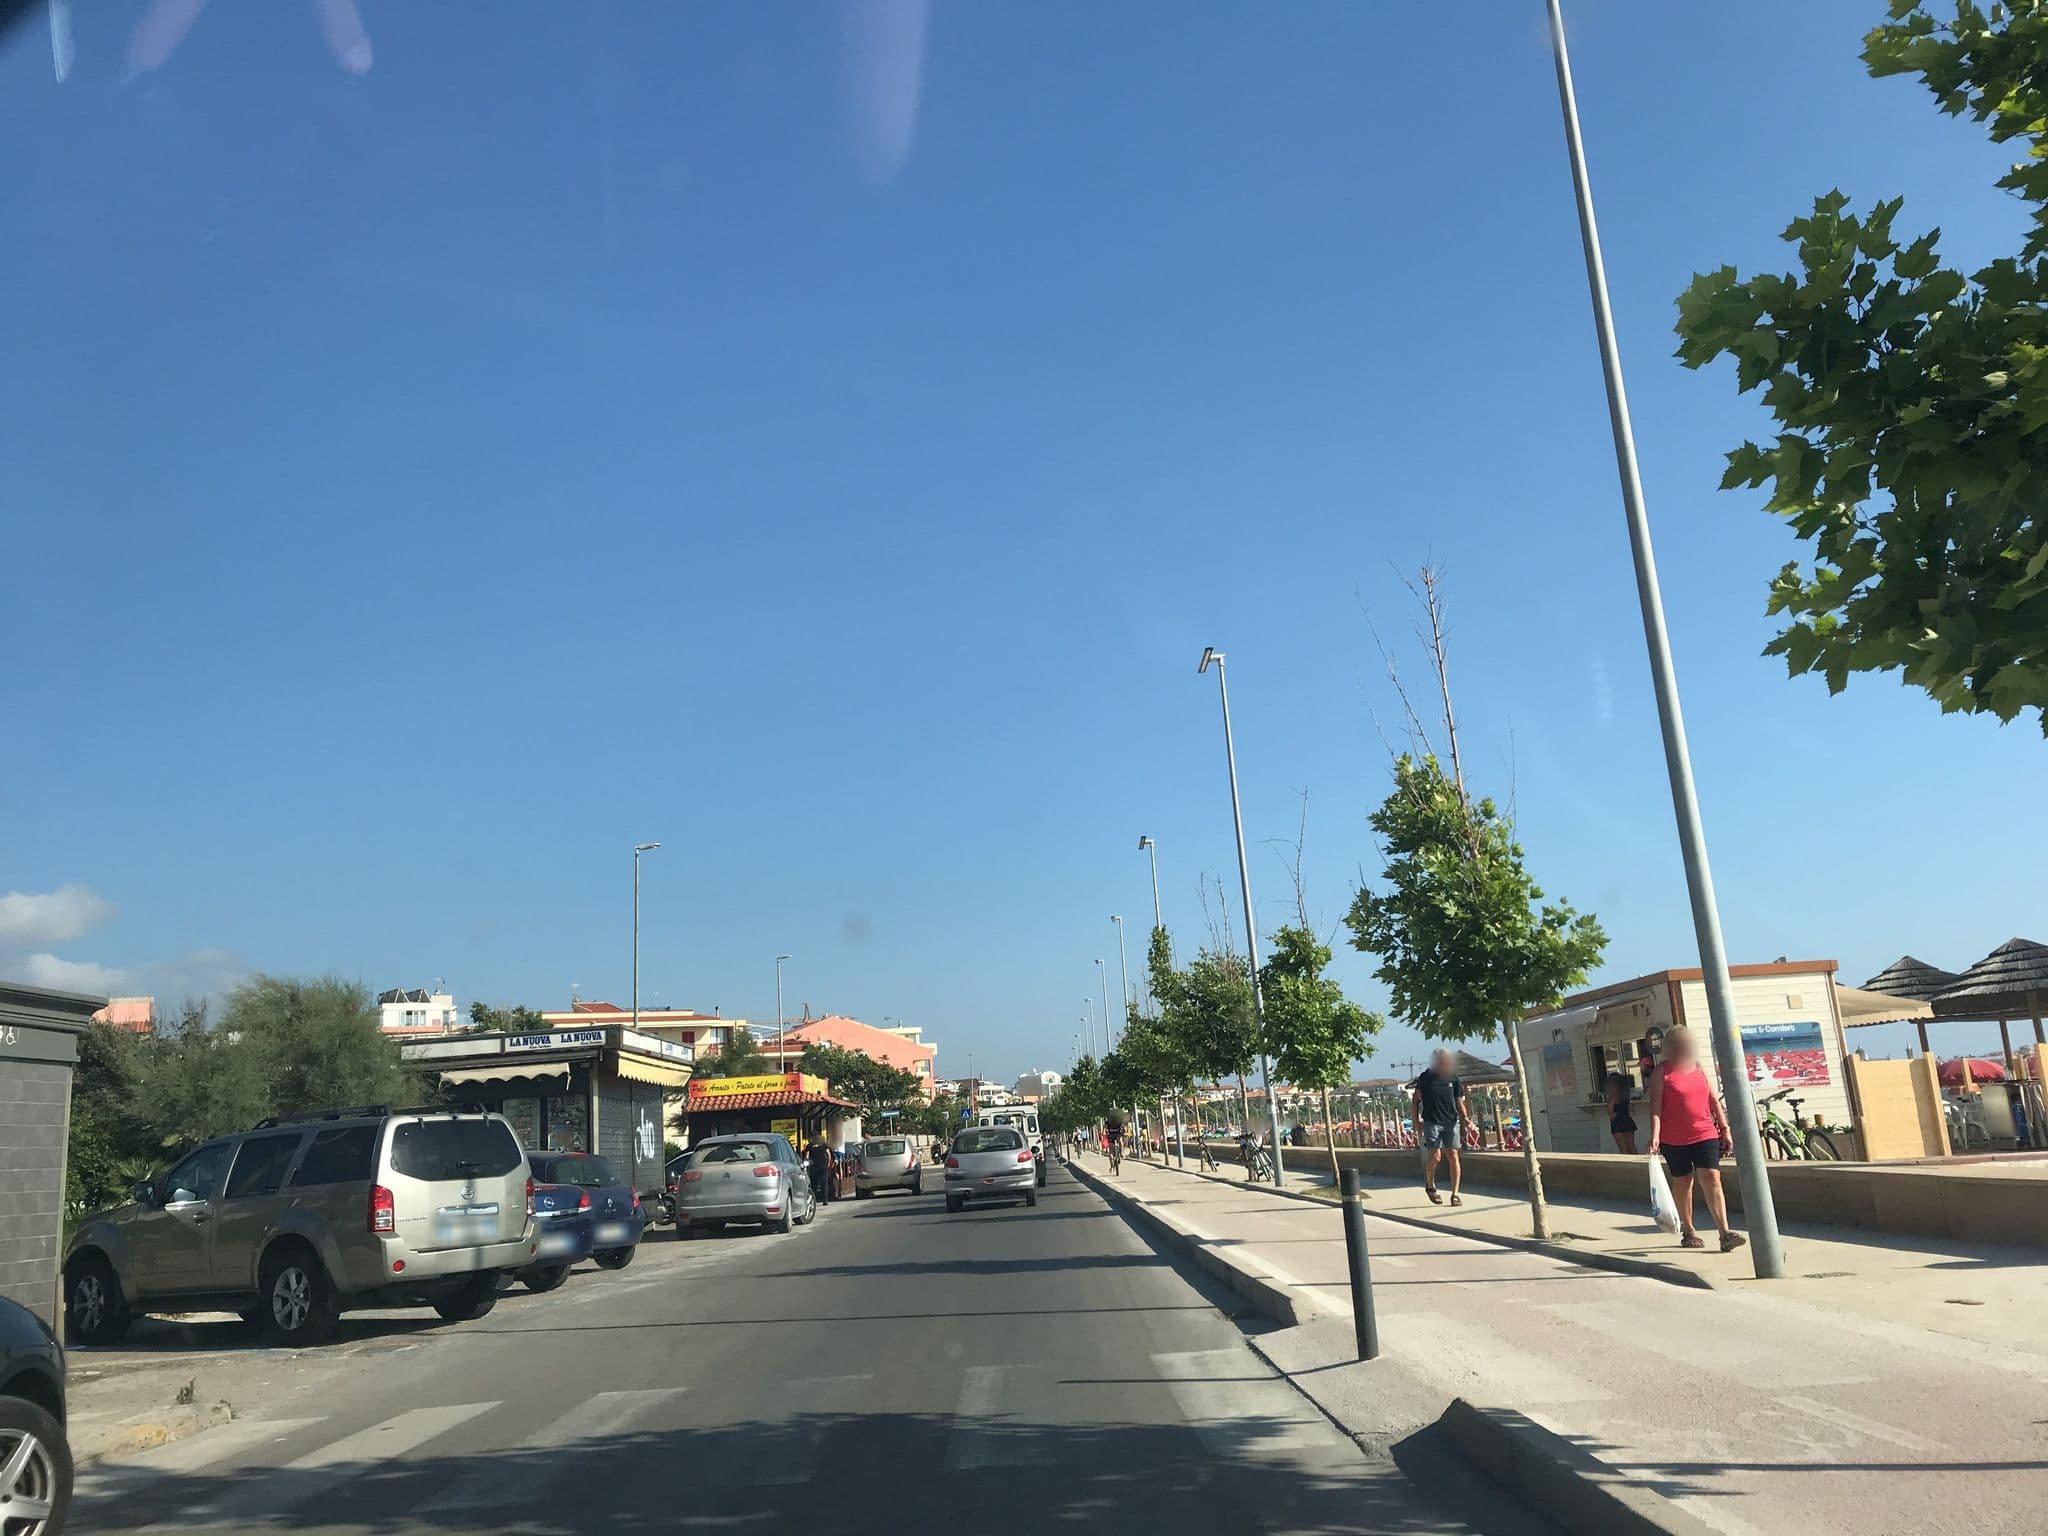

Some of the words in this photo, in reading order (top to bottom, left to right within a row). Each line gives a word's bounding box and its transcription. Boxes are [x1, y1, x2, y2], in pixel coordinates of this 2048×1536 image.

[509, 1038, 521, 1047] LA
[522, 1035, 551, 1046] NUOVA
[560, 1034, 572, 1043] LA
[573, 1031, 602, 1042] NUOVA
